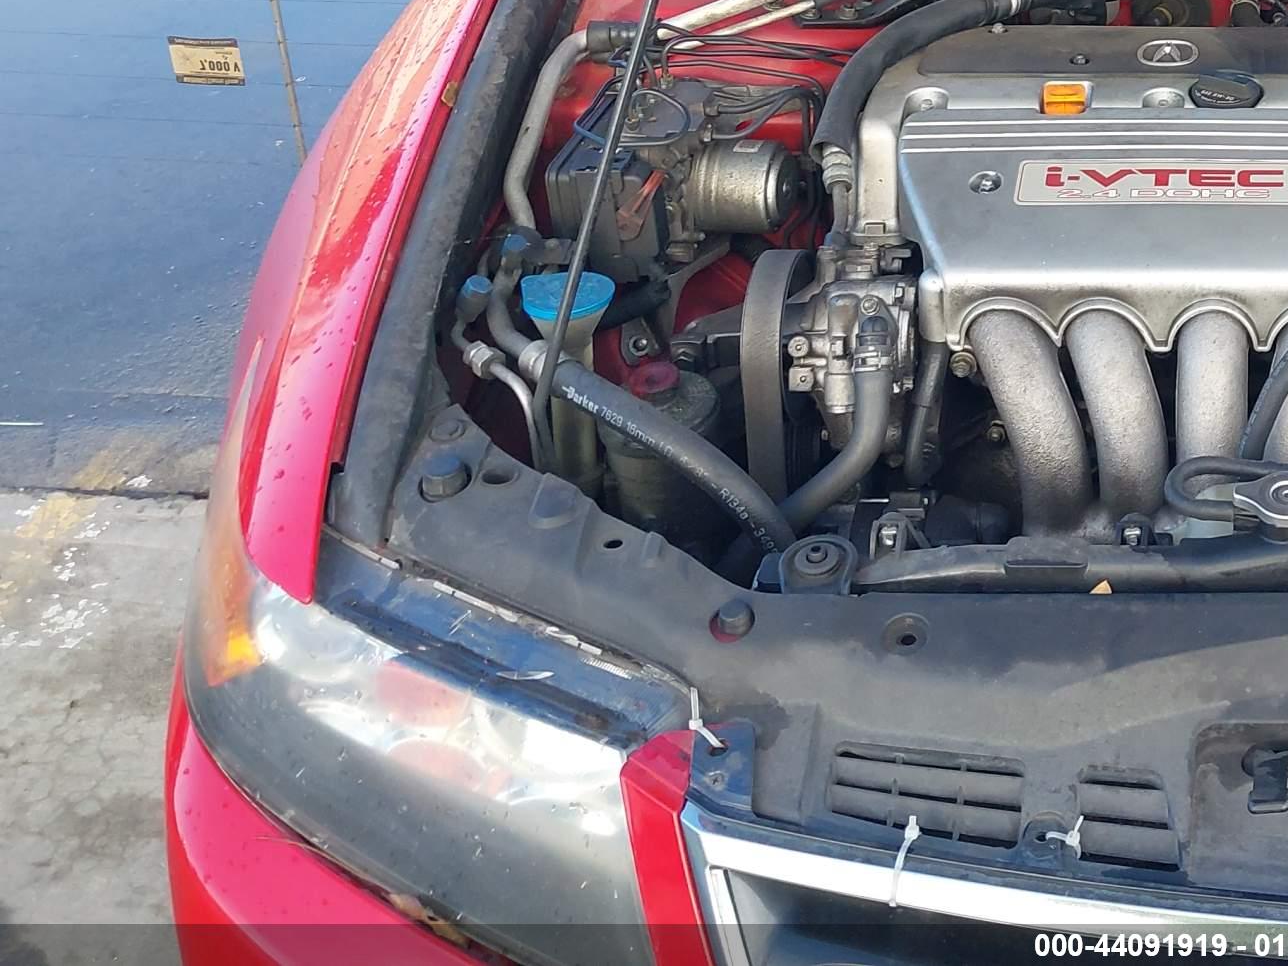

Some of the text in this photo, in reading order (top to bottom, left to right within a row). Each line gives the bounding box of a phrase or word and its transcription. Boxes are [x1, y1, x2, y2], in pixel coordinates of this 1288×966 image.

[1045, 166, 1284, 188] i-VTEC
[1056, 189, 1271, 199] 2.4 DOHC
